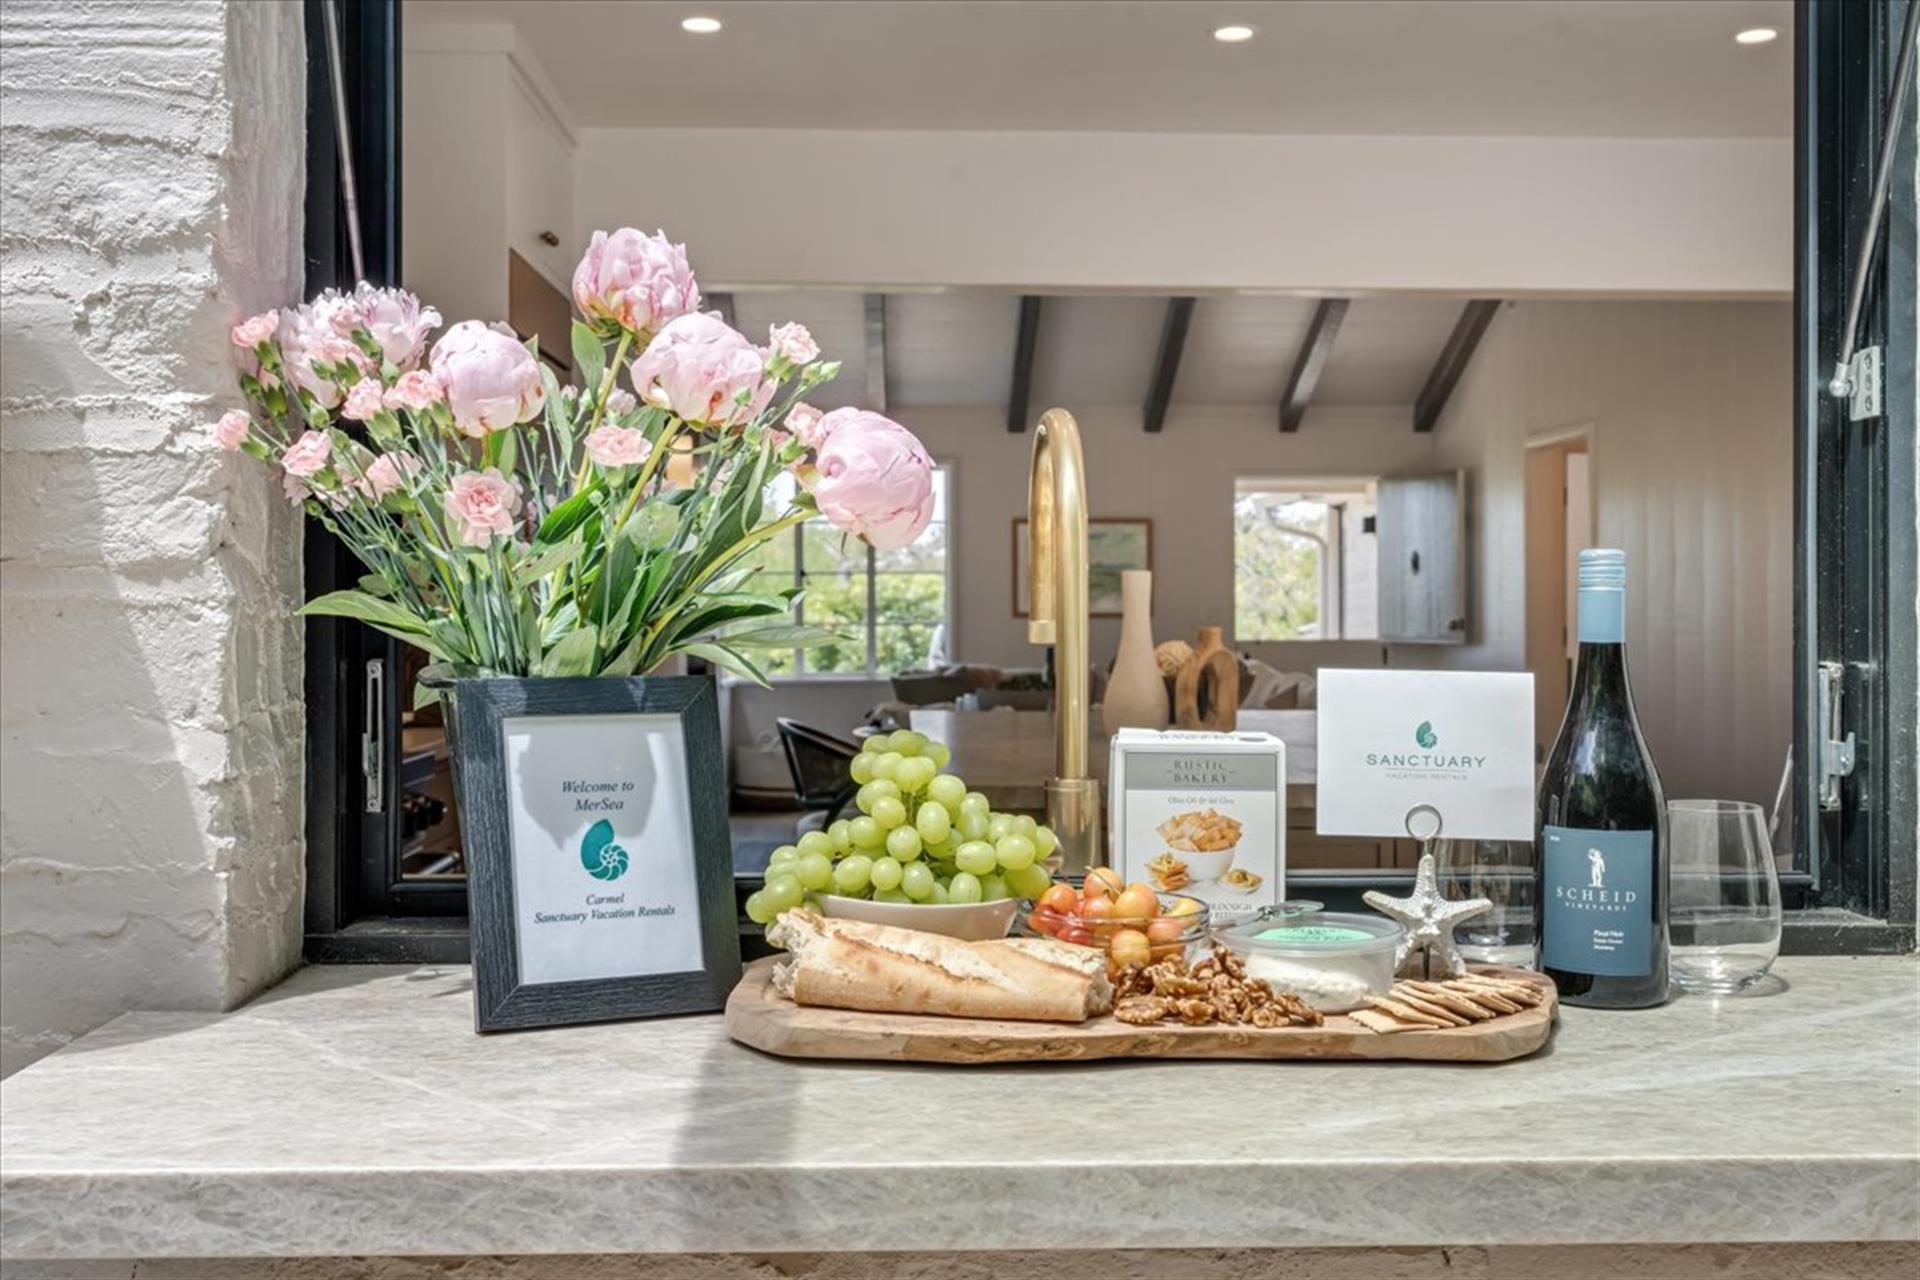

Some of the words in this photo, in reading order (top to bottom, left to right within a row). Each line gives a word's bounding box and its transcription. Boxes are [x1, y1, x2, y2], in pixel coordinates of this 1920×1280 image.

[1173, 760, 1227, 771] RUSTIC
[1366, 754, 1486, 768] SANCTUARY
[1173, 773, 1227, 784] BAKERY
[562, 780, 618, 793] Welcome
[622, 781, 634, 792] to
[574, 798, 624, 811] MerSea
[585, 893, 624, 906] Carmel
[1556, 886, 1637, 903] SCHEID
[1565, 901, 1627, 911] VINEYARDS
[534, 909, 588, 924] Sanctuary
[591, 907, 635, 920] Vacation
[637, 905, 676, 917] Rentals
